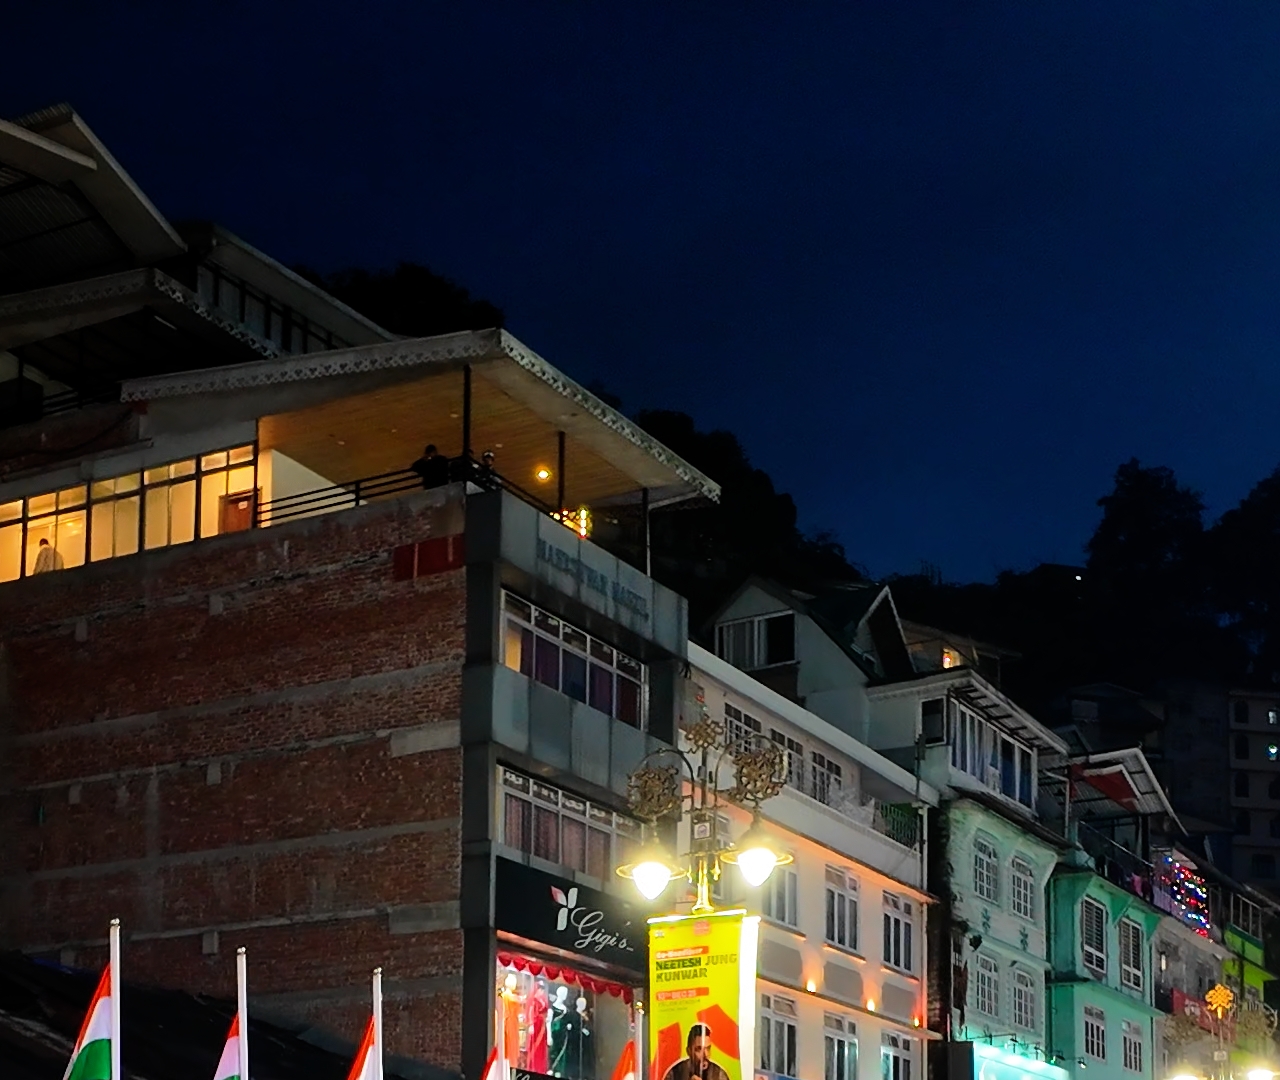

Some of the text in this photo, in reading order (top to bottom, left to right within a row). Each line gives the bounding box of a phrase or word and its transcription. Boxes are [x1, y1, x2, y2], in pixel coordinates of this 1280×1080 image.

[656, 953, 738, 971] NEETESH JUNG
[656, 967, 708, 983] KUNWAR
